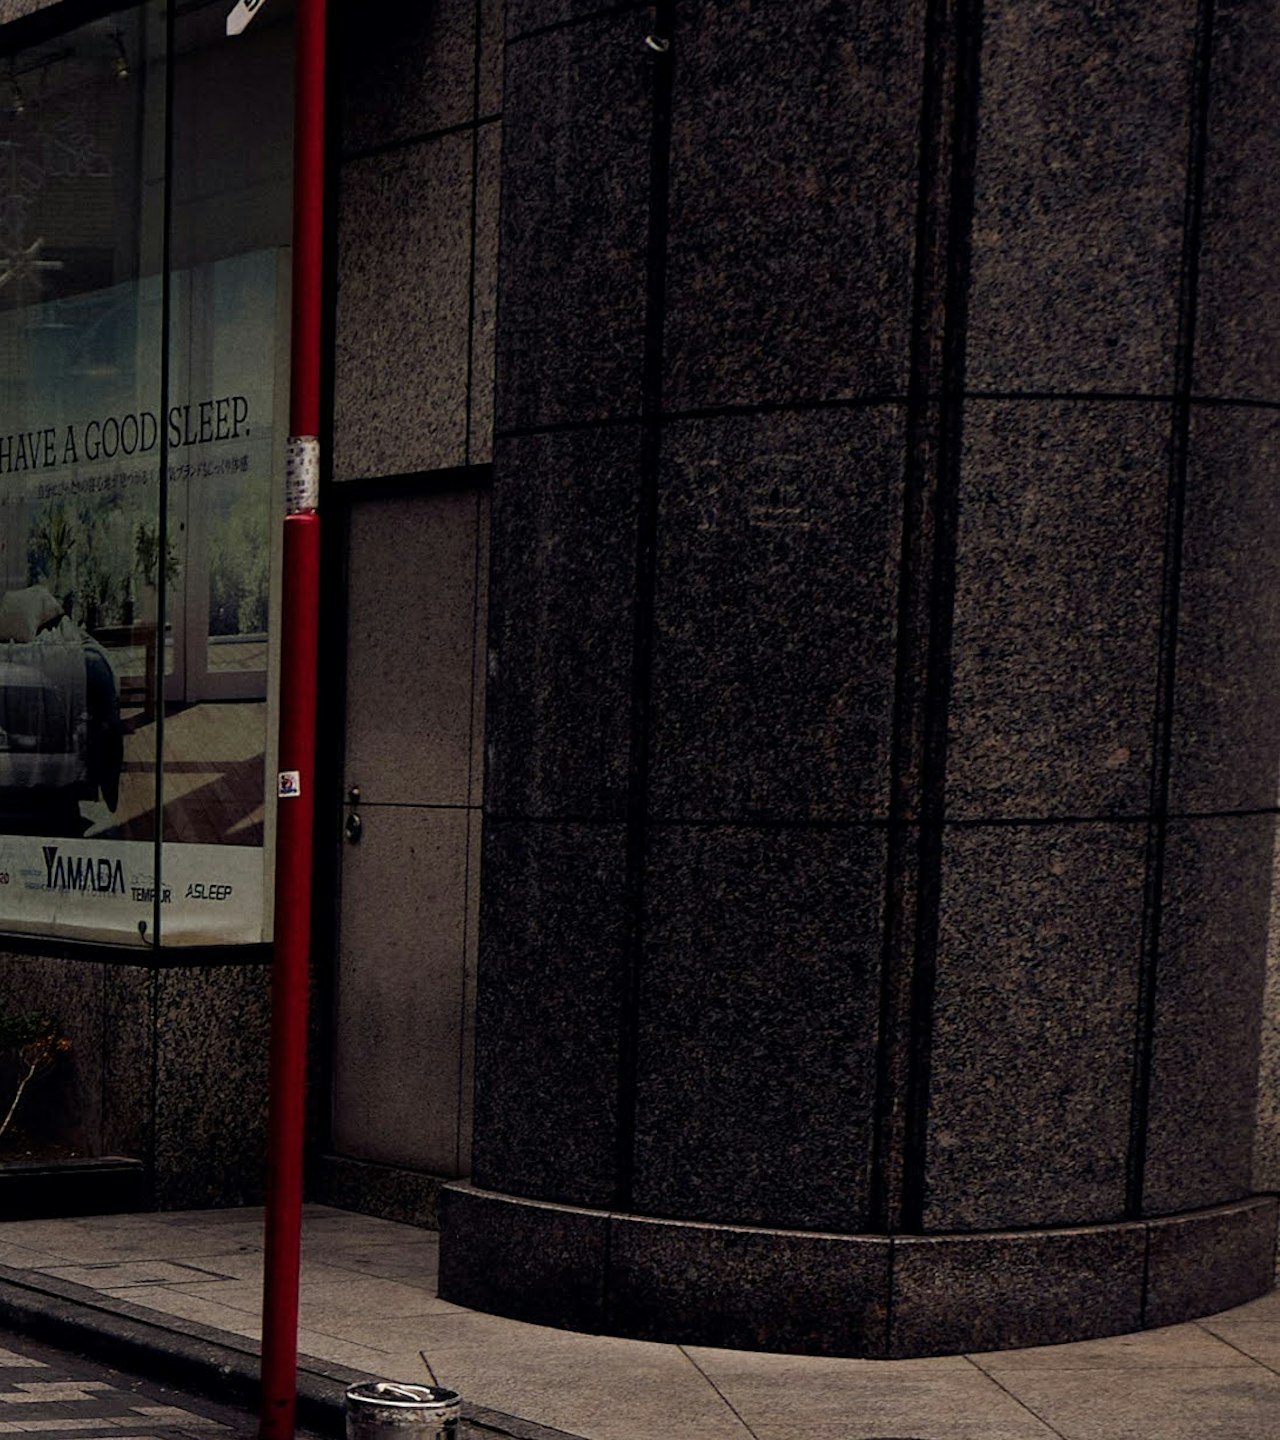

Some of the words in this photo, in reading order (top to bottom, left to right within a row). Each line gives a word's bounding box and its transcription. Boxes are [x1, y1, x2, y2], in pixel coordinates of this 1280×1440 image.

[62, 425, 78, 464] A
[85, 412, 157, 461] GOOD
[168, 396, 251, 449] SLEEP.
[43, 846, 126, 893] YAMADA
[185, 883, 233, 900] ASLEEP
